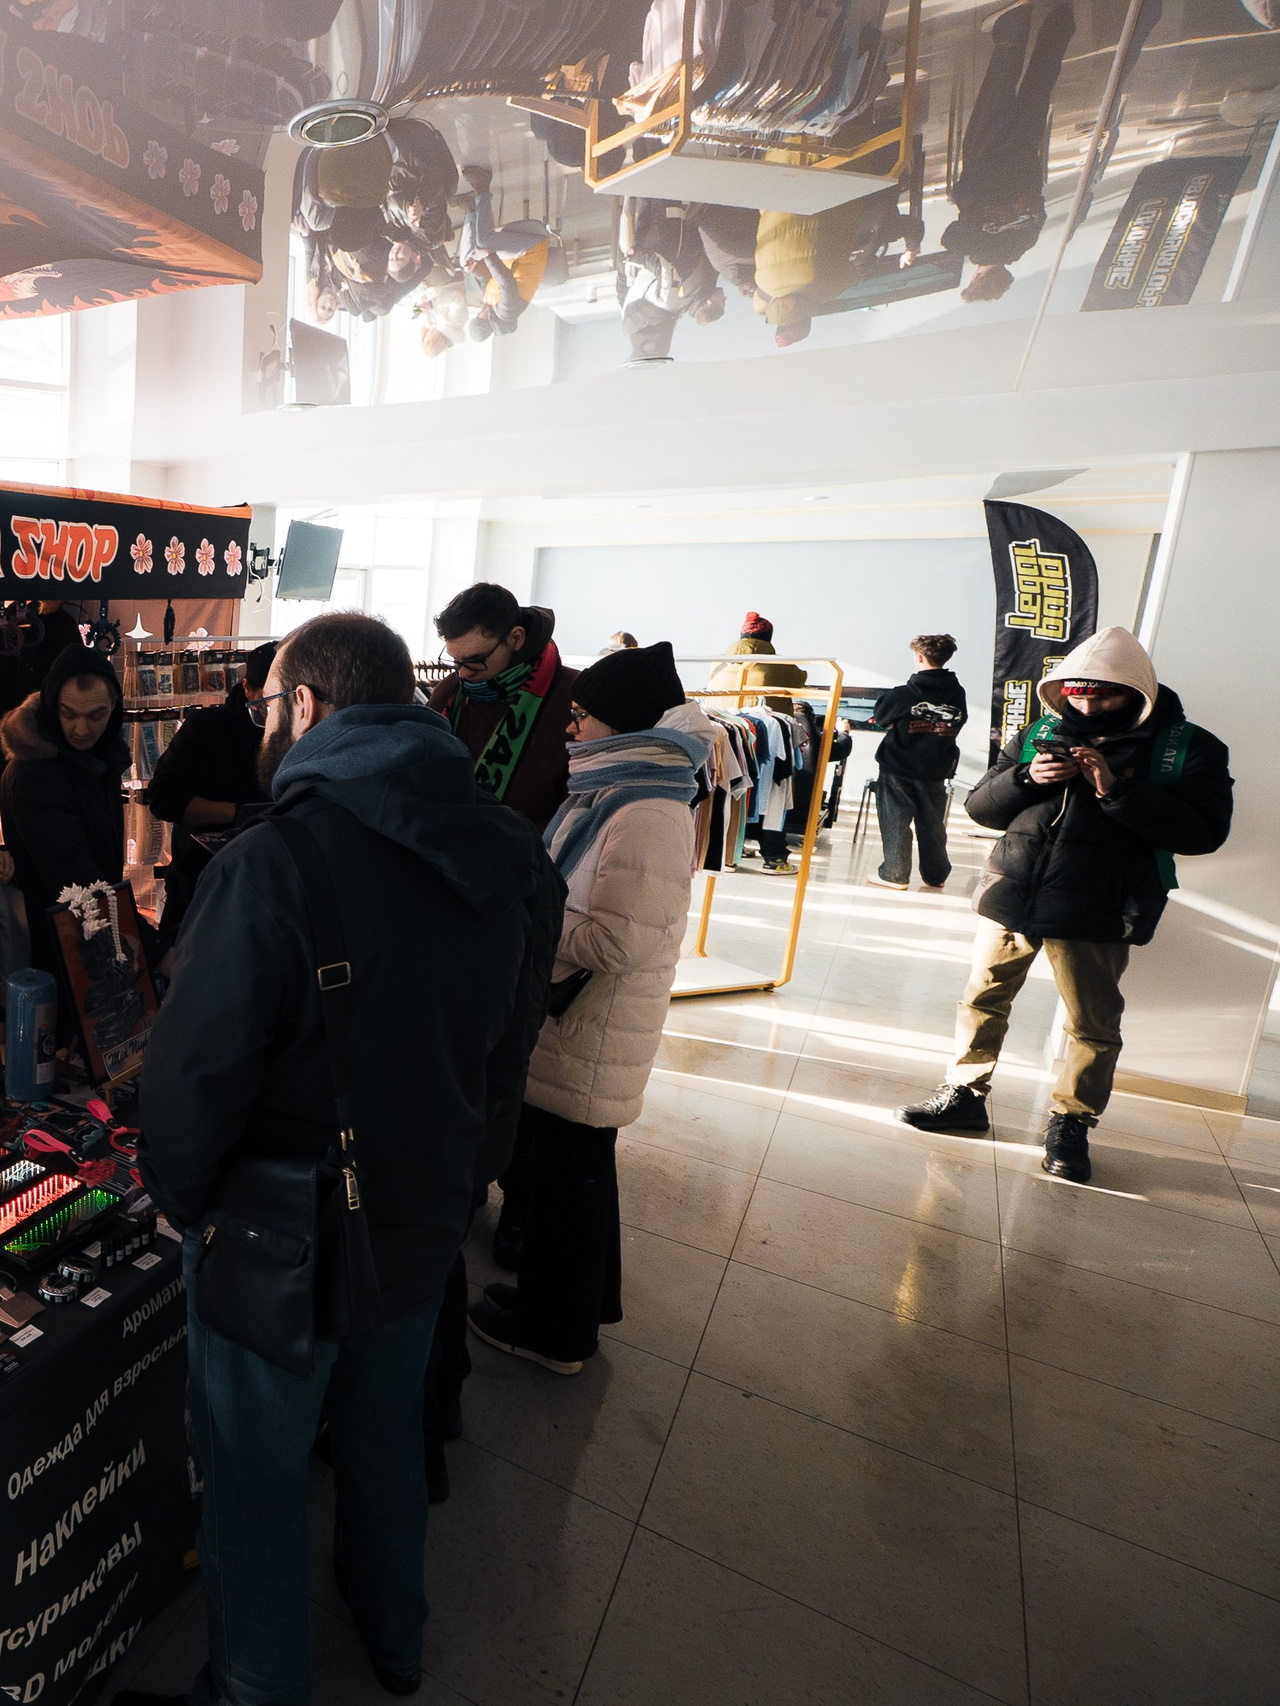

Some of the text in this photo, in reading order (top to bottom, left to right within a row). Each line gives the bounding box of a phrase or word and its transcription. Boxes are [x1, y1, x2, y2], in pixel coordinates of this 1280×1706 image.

[11, 515, 119, 583] SHOP
[1160, 725, 1185, 772] TAKATA
[8, 1423, 83, 1500] Одежда
[86, 1388, 109, 1435] для
[14, 1438, 146, 1586] Наклейки
